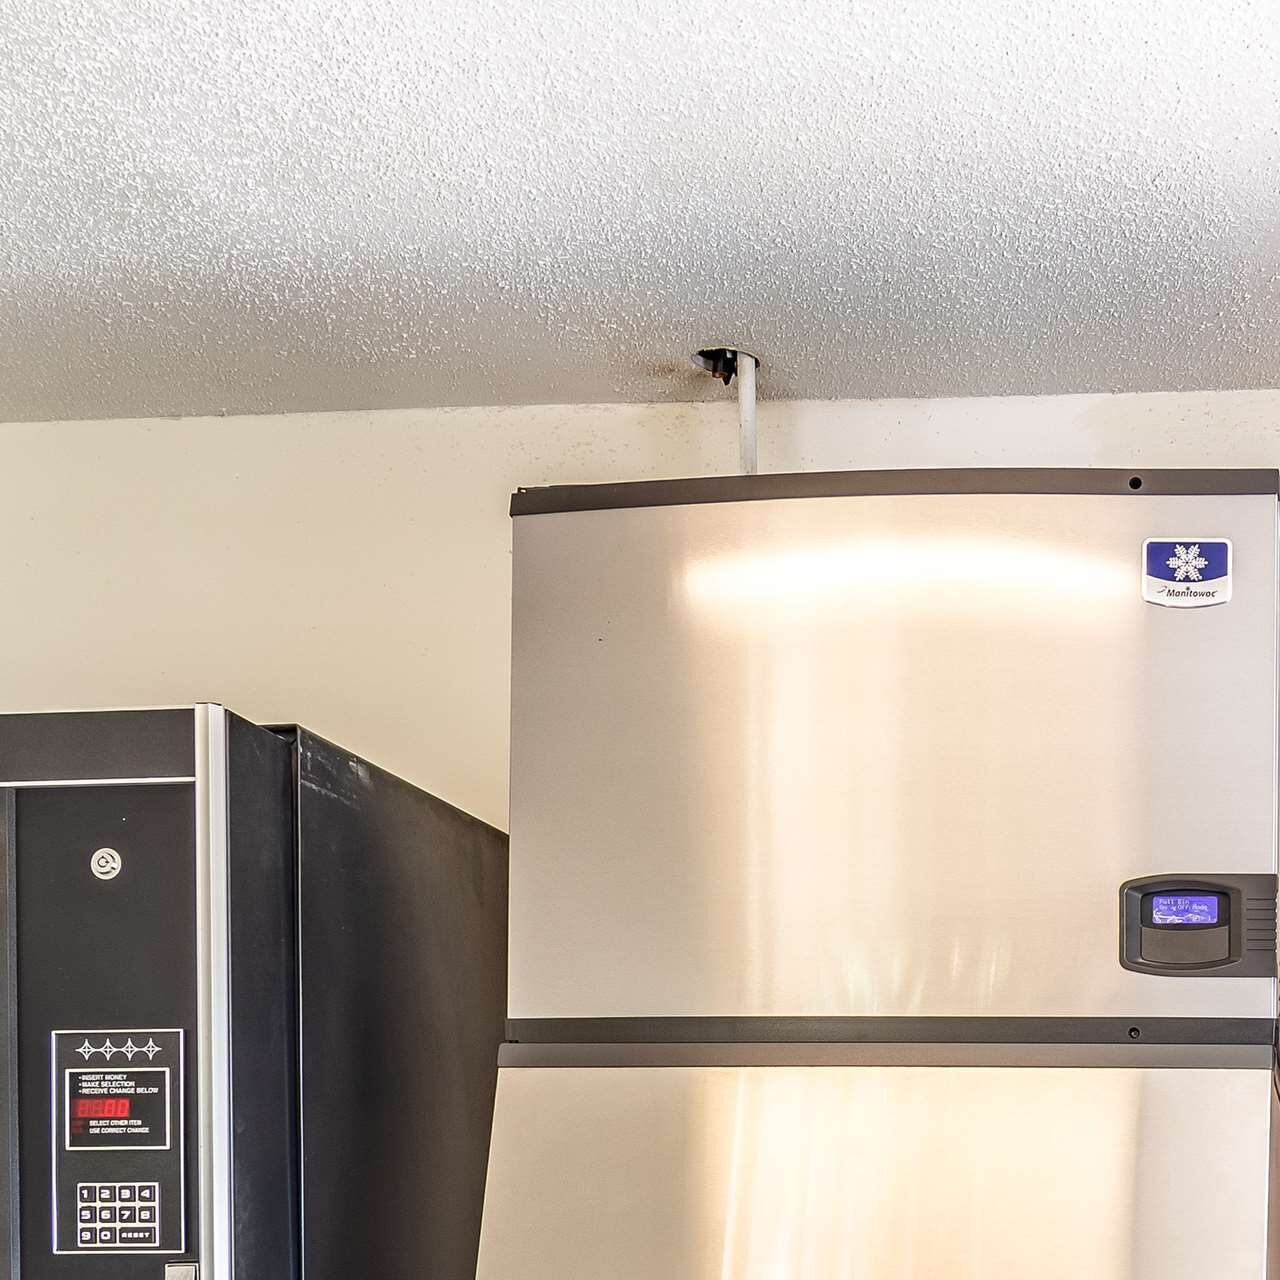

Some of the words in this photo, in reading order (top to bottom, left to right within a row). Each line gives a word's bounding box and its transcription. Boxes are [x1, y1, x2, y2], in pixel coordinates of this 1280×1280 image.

[1166, 586, 1218, 598] Manitowoc
[81, 1189, 88, 1199] 1
[100, 1189, 111, 1199] 2
[120, 1189, 131, 1199] 3
[140, 1189, 151, 1199] 4
[81, 1210, 91, 1220] 5
[100, 1210, 111, 1219] 6
[120, 1210, 131, 1219] 7
[140, 1210, 151, 1219] 8
[81, 1231, 91, 1240] 9
[100, 1231, 111, 1240] 0
